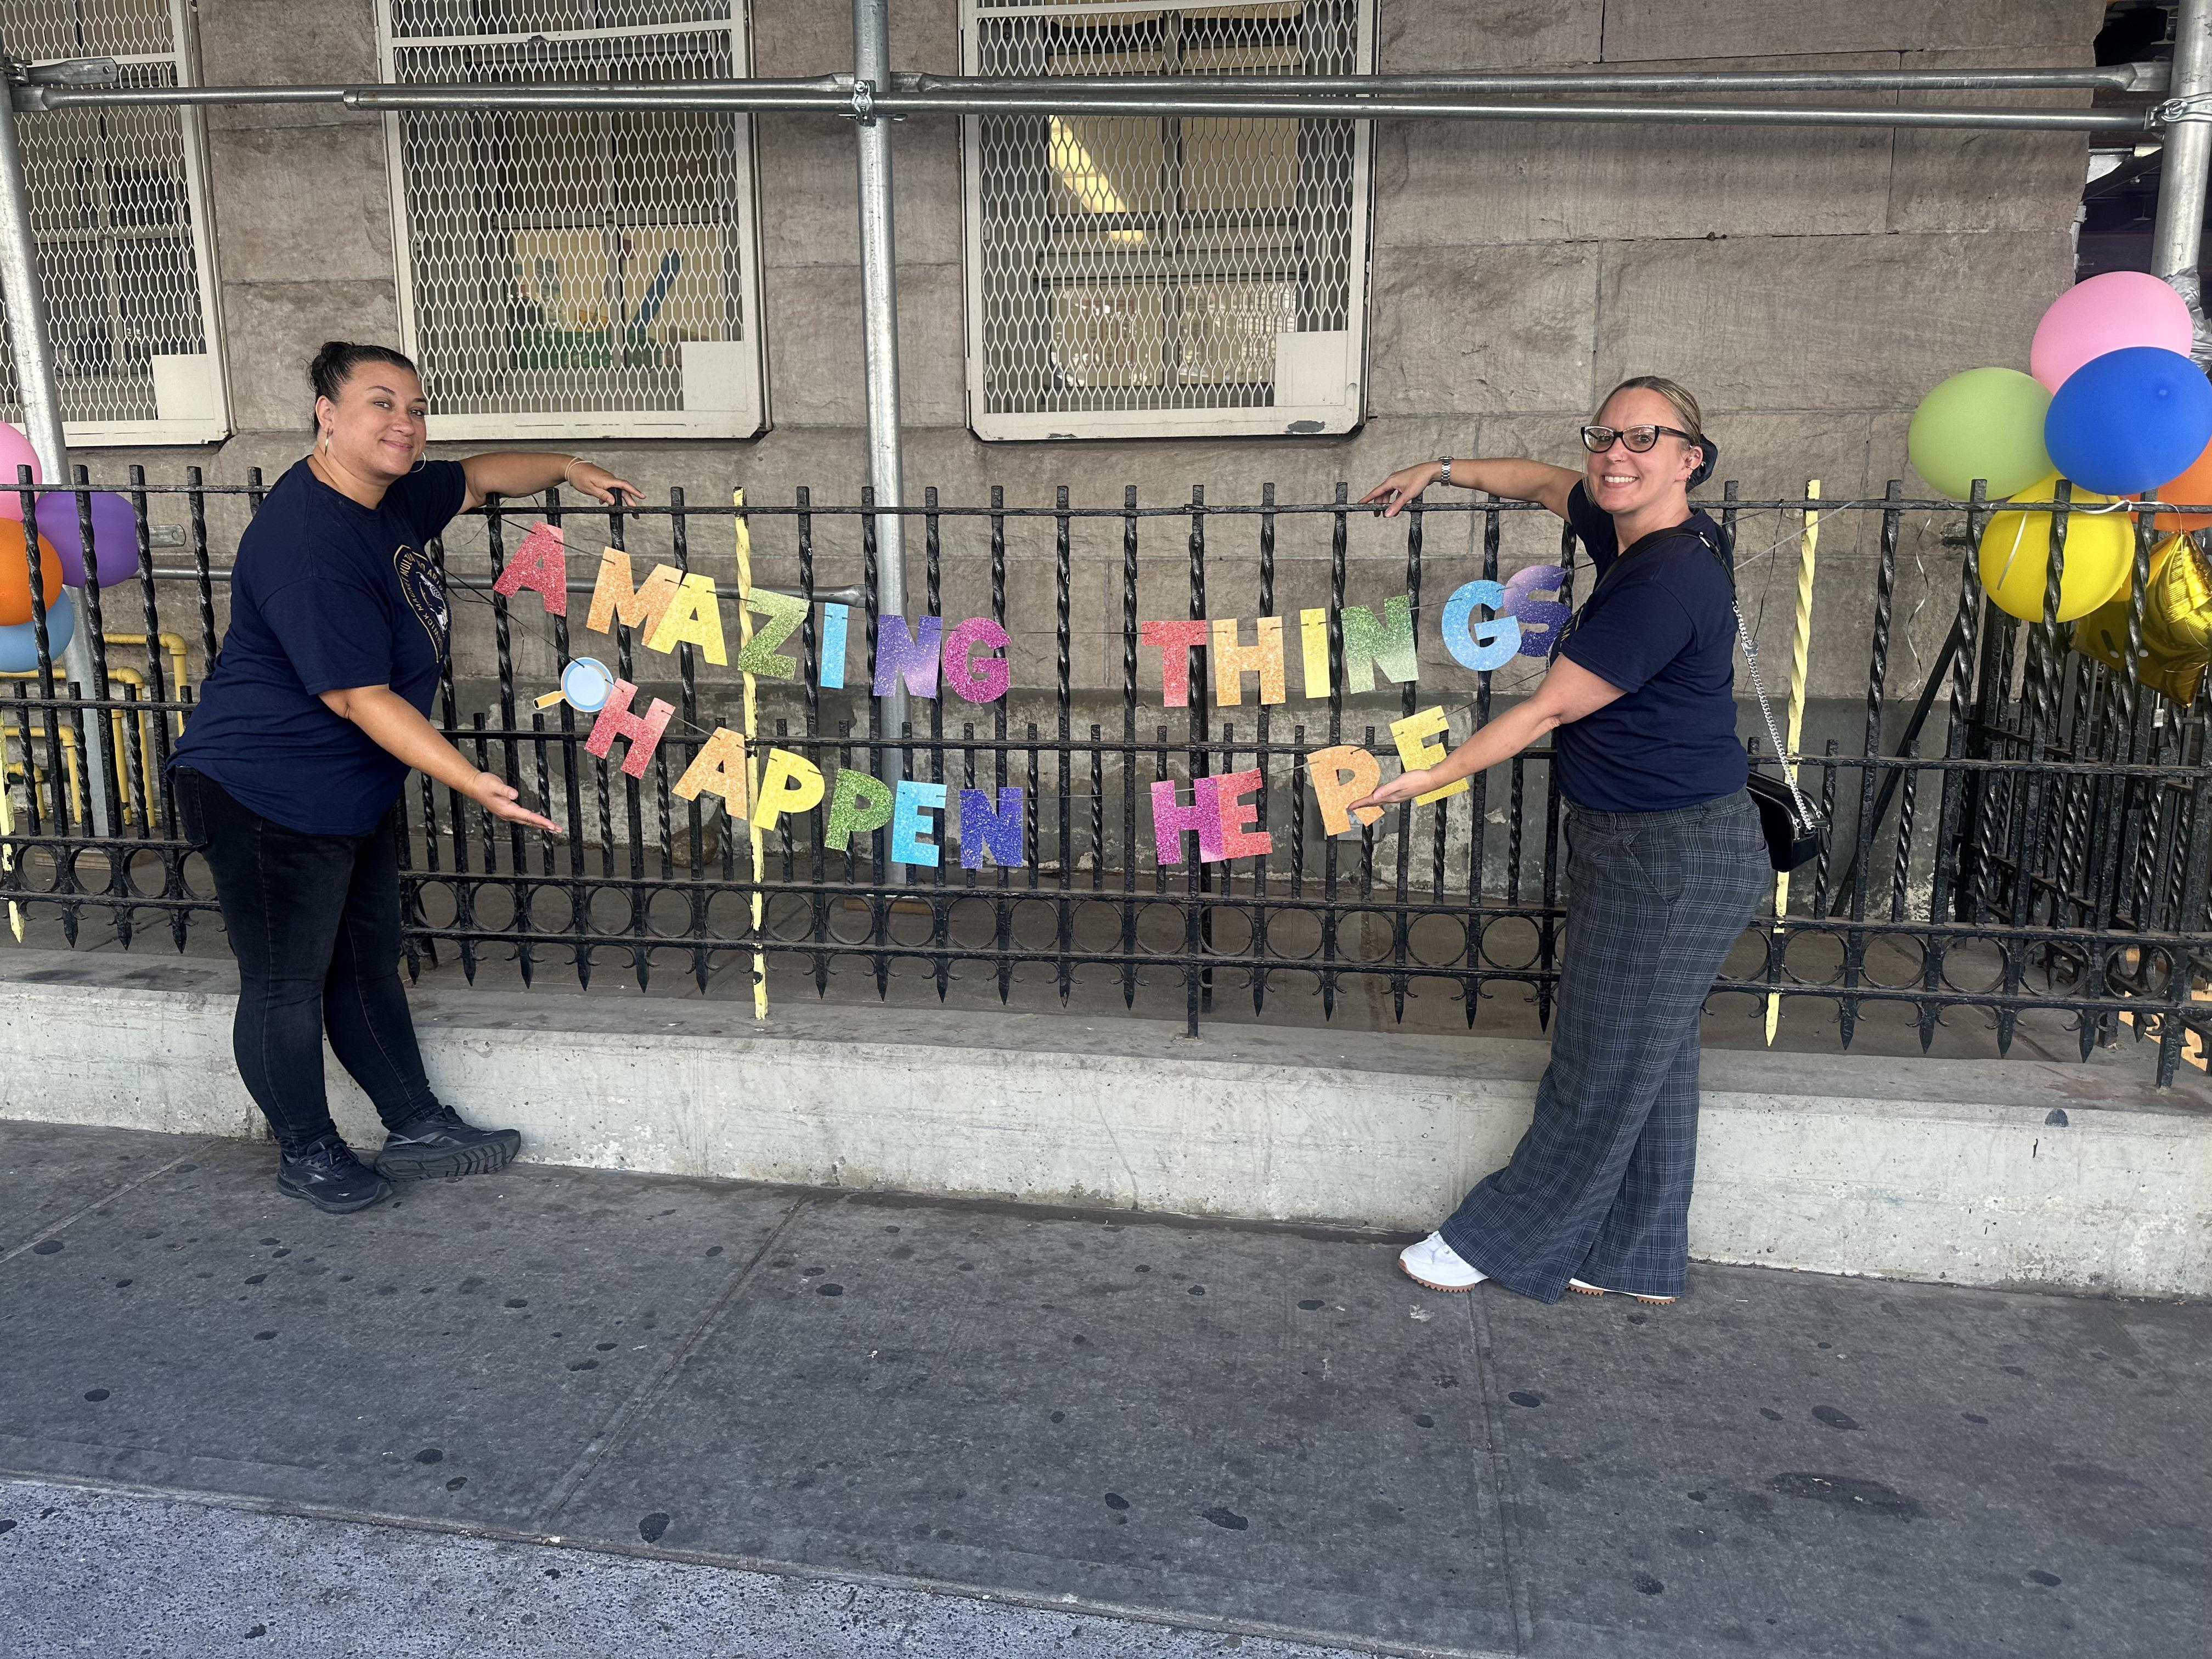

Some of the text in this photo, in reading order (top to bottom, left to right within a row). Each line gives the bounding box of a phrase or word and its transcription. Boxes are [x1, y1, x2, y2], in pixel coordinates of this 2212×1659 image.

[493, 522, 1572, 707] AMAZING THINGS
[584, 678, 1023, 869] HAPPEN
